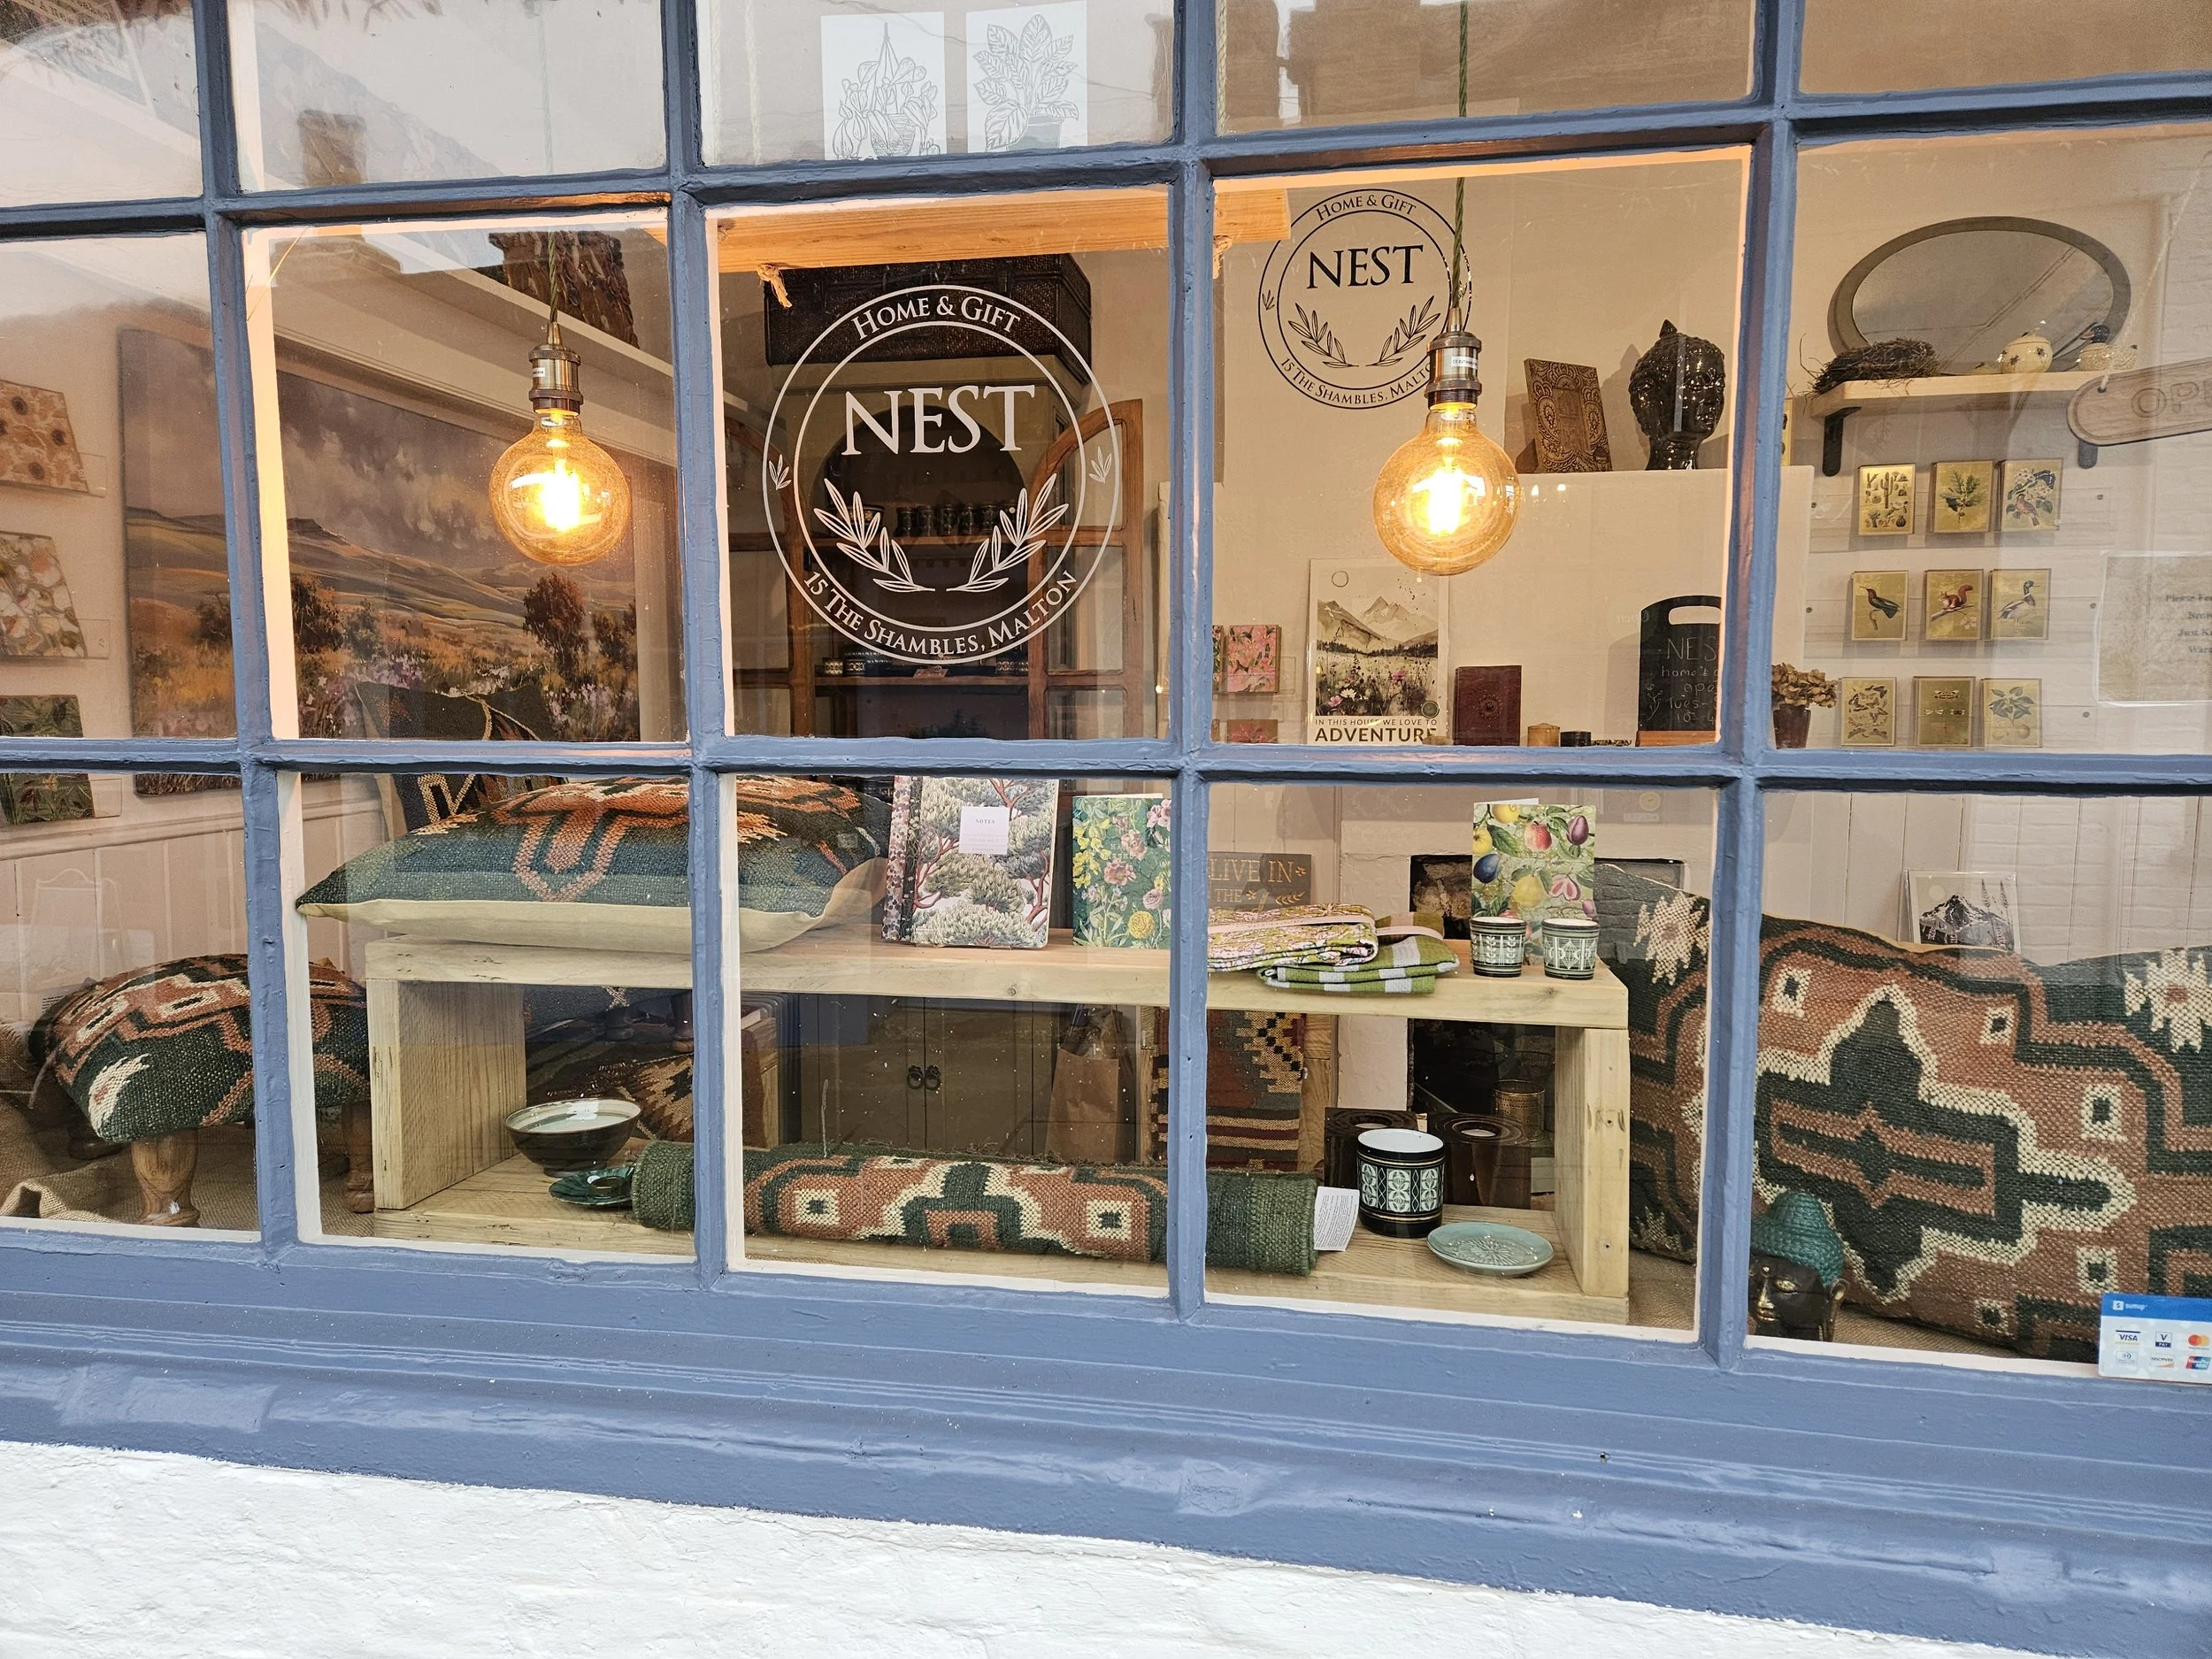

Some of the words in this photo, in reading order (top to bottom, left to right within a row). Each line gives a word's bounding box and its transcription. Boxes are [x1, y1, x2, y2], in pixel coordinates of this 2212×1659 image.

[1316, 196, 1363, 221] HOME
[1366, 194, 1378, 207] &
[1380, 194, 1417, 216] GIFT
[1306, 244, 1424, 289] NEST
[850, 297, 931, 341] HOME
[936, 296, 956, 316] &
[961, 296, 1021, 334] GIFT
[1281, 357, 1295, 372] 15
[1292, 367, 1316, 392] THE
[1389, 362, 1431, 399] MALTO
[841, 384, 1036, 456] NEST
[803, 571, 829, 595] 15
[824, 588, 864, 632] THE
[987, 570, 1077, 648] MALTON
[1315, 727, 1437, 742] ADVENTURE
[1210, 858, 1261, 883] LIVE
[1268, 860, 1294, 884] IN
[1215, 888, 1242, 902] THE
